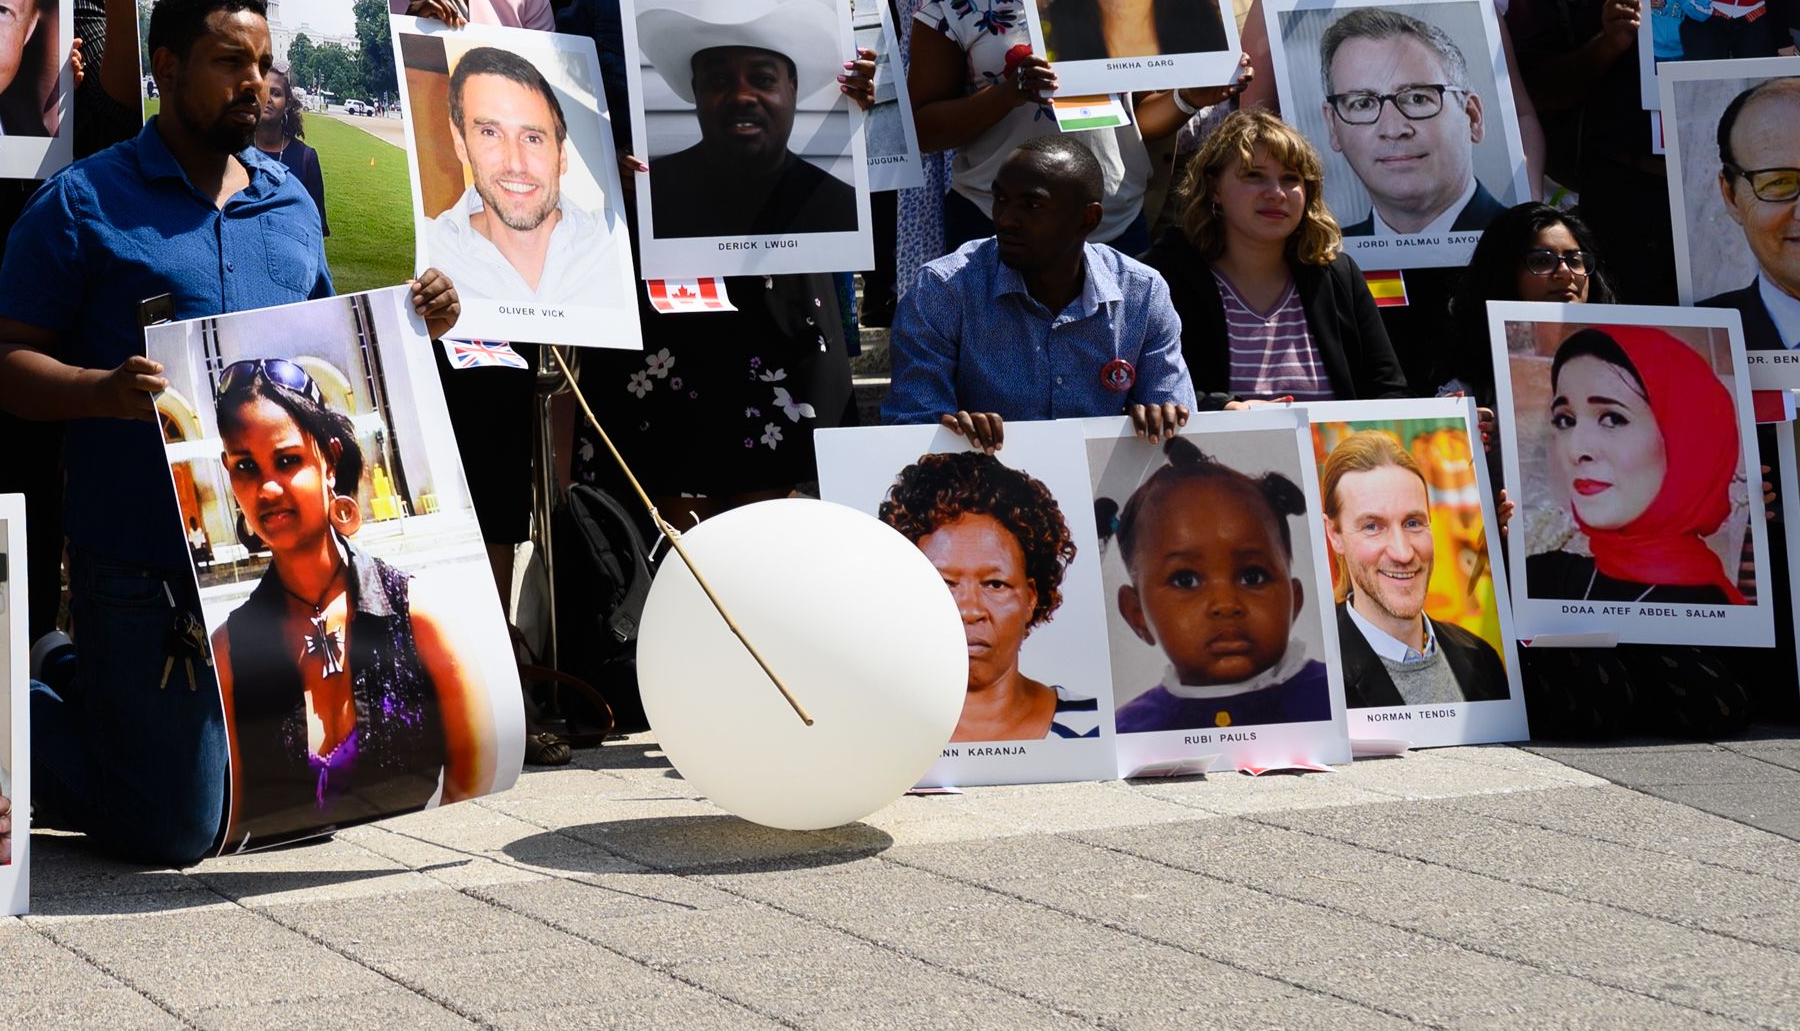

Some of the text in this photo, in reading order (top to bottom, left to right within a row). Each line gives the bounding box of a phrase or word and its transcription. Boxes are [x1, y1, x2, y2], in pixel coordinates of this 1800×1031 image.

[1106, 59, 1175, 71] SHIKHA GARG
[717, 239, 799, 251] DERICK LWUGI
[1357, 240, 1389, 249] JORDI
[1396, 238, 1440, 247] DALMAU
[498, 306, 566, 319] OLIVER VICK
[1748, 356, 1769, 364] DR.
[1561, 606, 1727, 619] DOAA ATEF ABDEL SALAM
[1367, 709, 1457, 723] NORMAN TENDIS
[1184, 731, 1257, 745] RUBI PAULS
[967, 745, 1027, 757] KARANJA
